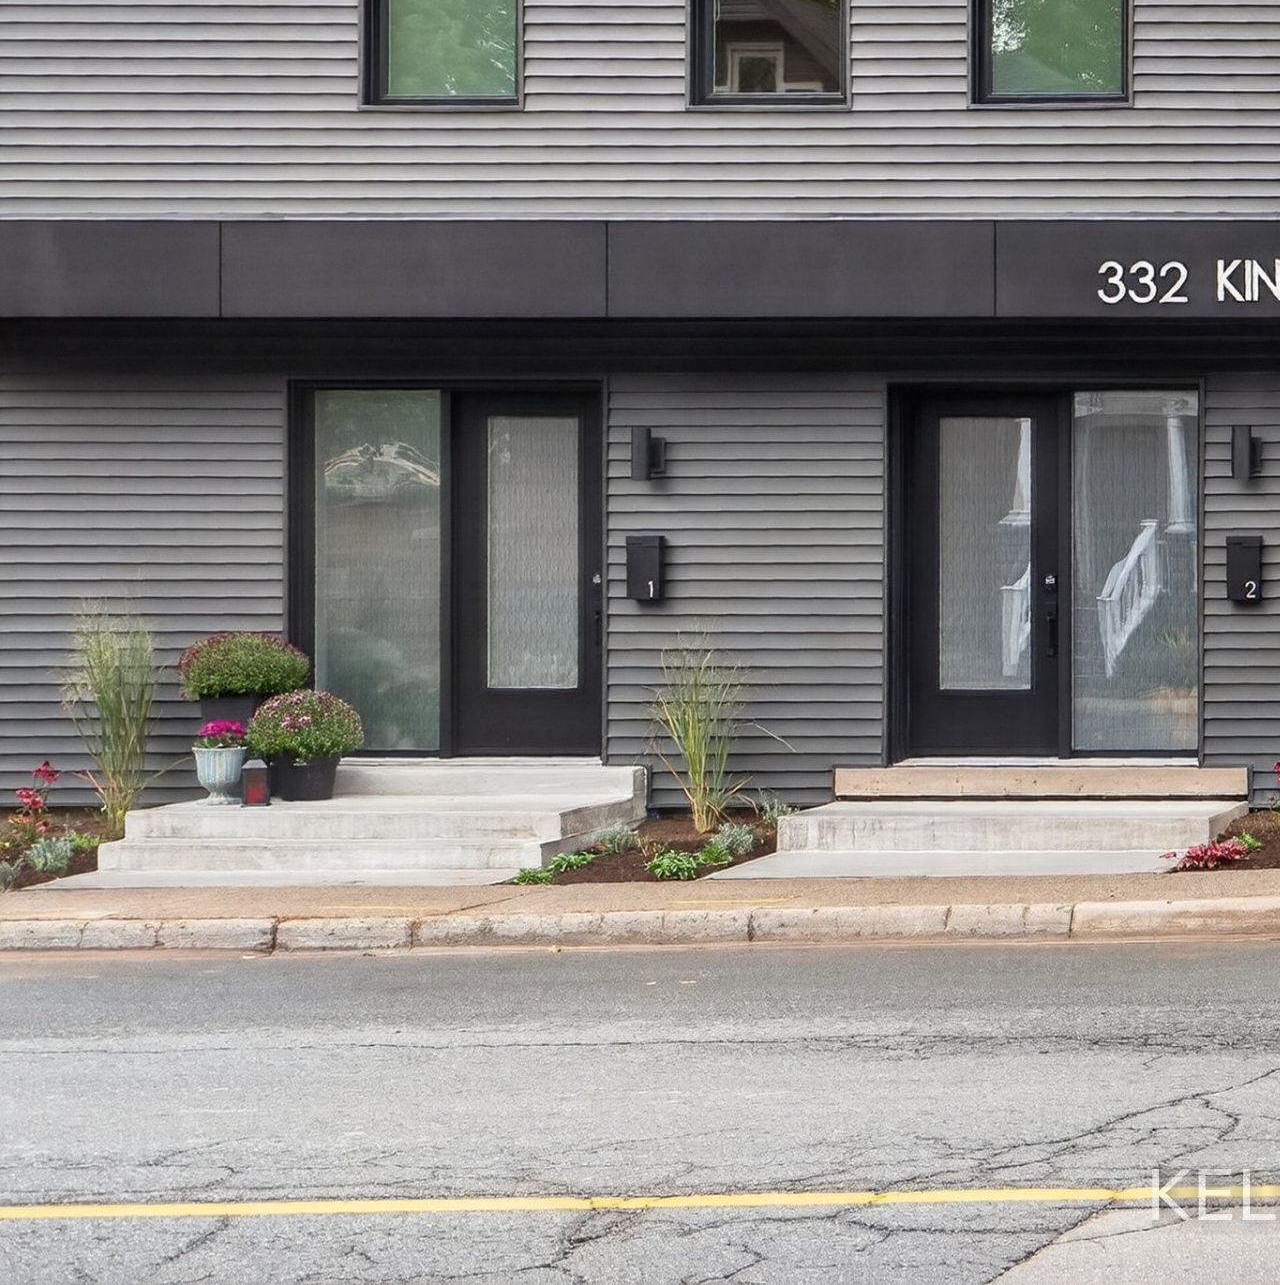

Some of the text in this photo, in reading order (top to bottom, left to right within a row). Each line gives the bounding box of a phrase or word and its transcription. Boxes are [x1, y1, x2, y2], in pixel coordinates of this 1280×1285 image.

[1098, 260, 1189, 304] 332
[647, 580, 654, 598] 1
[1245, 580, 1257, 599] 2
